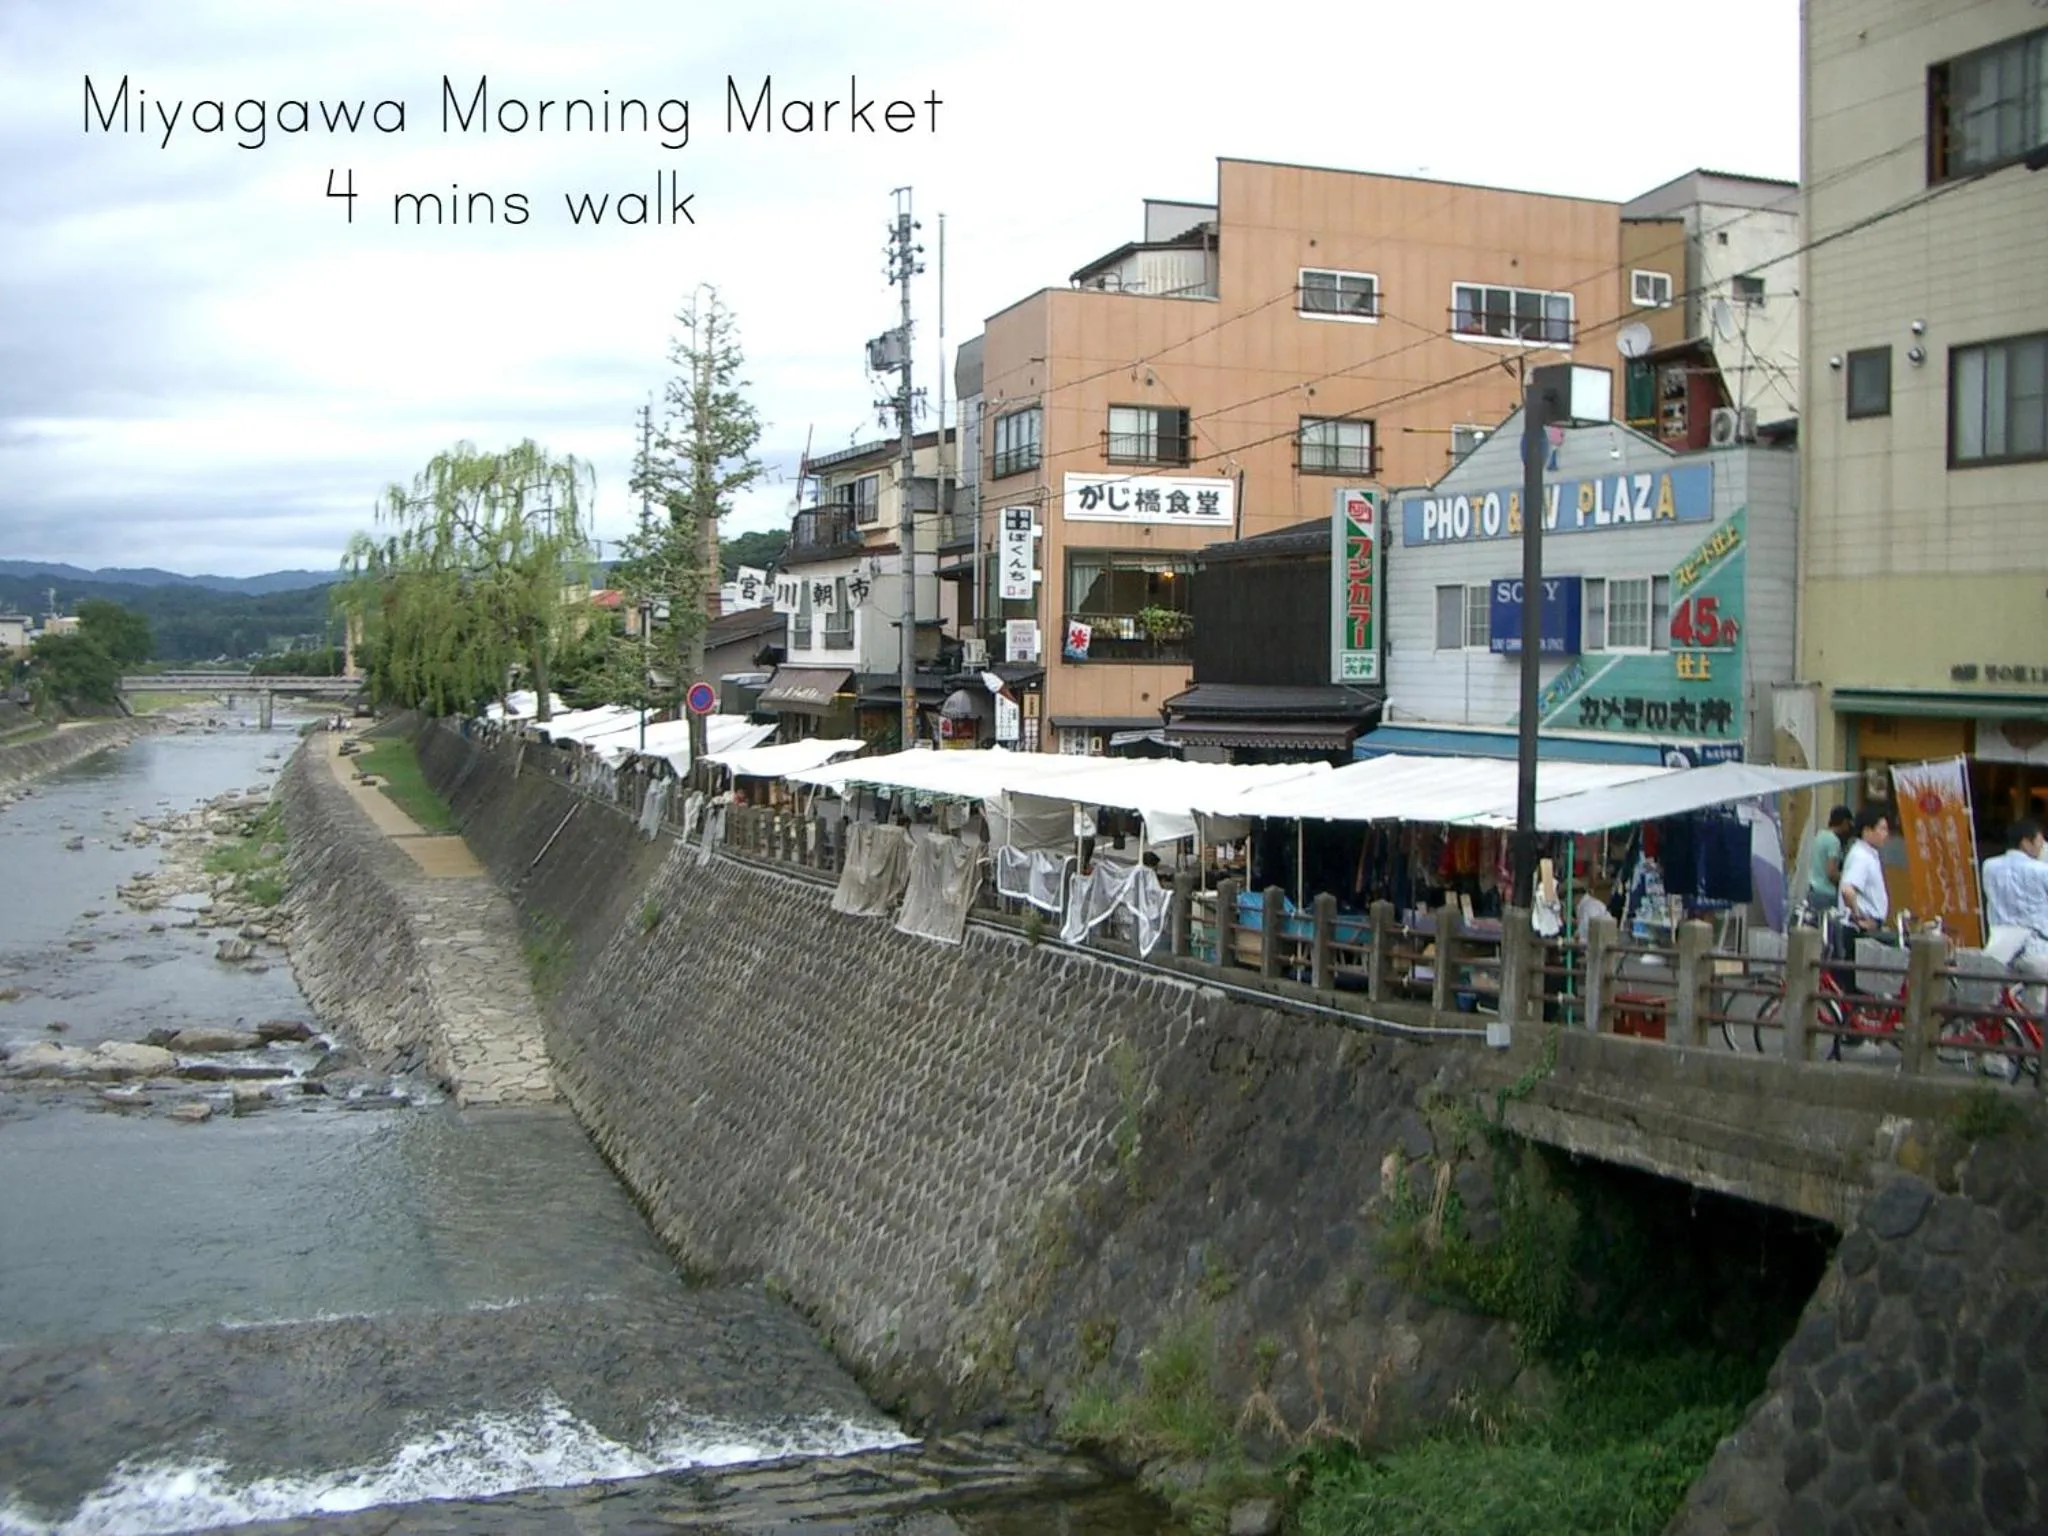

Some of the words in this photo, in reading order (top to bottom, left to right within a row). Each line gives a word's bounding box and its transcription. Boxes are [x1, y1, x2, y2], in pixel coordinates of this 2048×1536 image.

[1423, 491, 1500, 540] PHOTO
[1576, 473, 1676, 526] PLAZA
[740, 574, 871, 608] 宮川朝市
[1347, 536, 1373, 648] フジカラー
[1497, 581, 1559, 603] SOY
